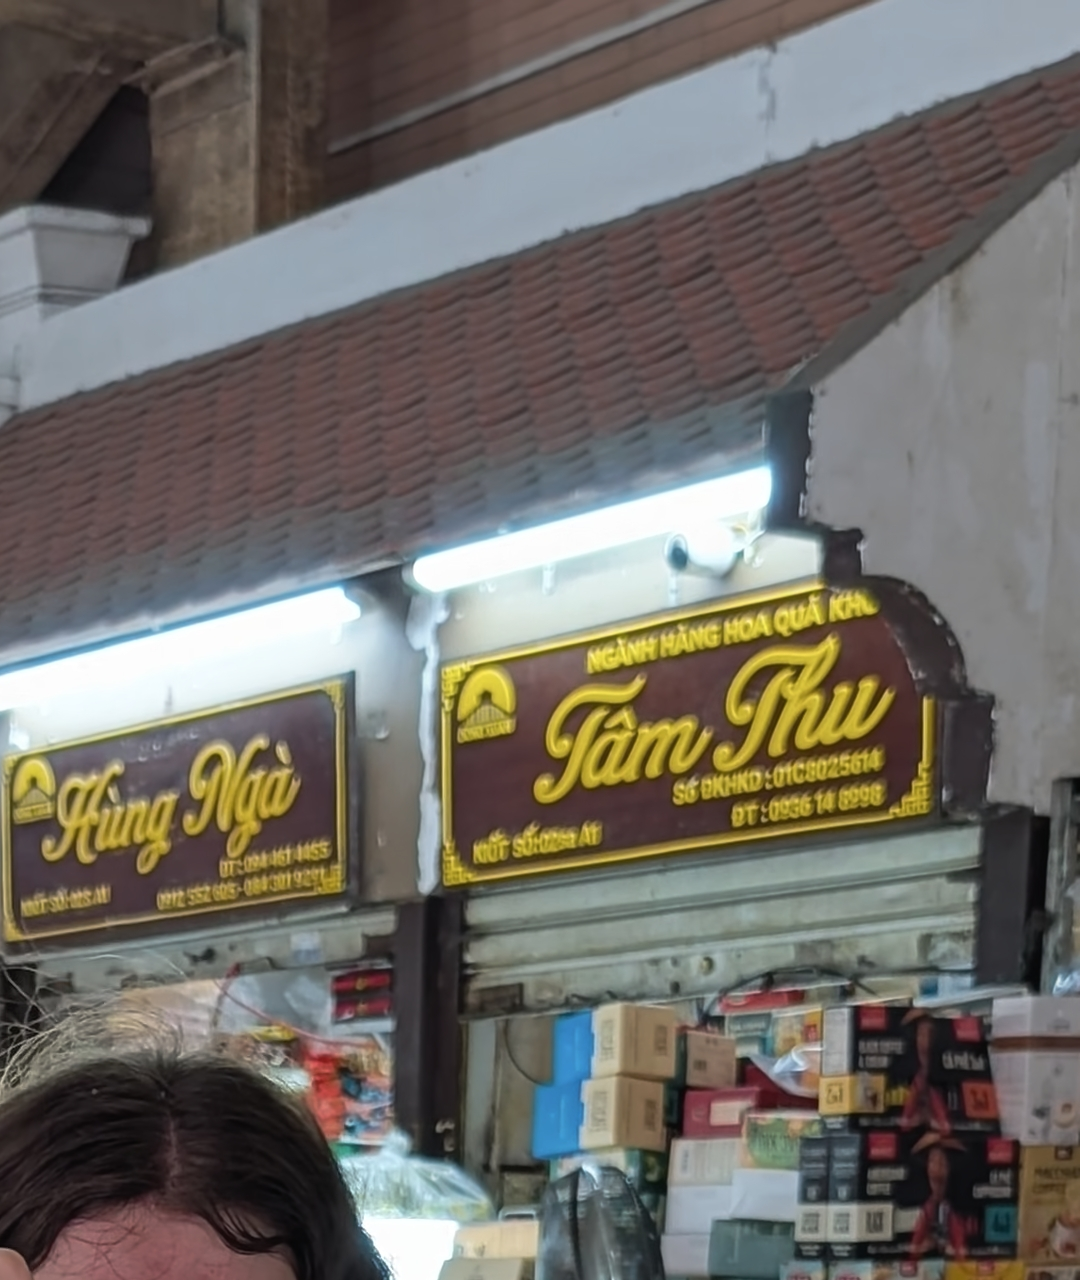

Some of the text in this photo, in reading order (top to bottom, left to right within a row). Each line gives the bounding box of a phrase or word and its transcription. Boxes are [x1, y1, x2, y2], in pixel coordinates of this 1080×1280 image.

[722, 612, 772, 645] HOA
[533, 632, 897, 804] Tâm Thu
[41, 733, 302, 874] Hùng Ngà
